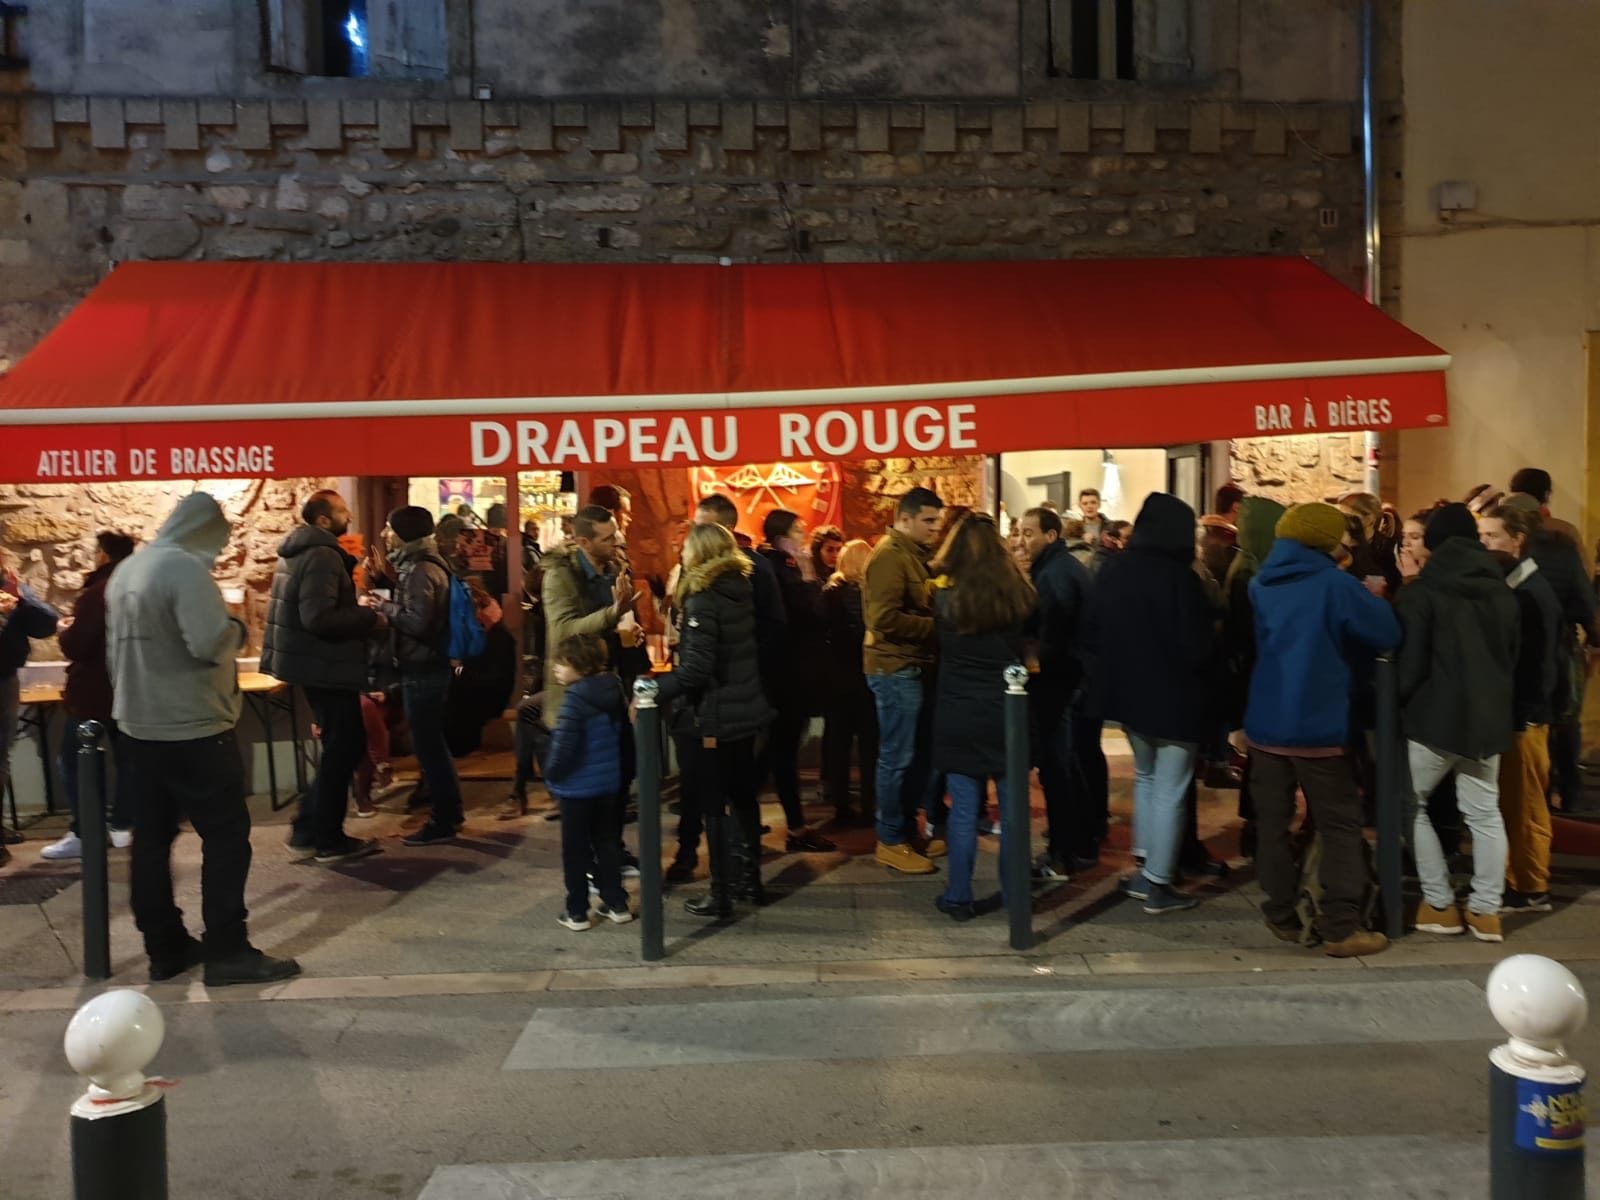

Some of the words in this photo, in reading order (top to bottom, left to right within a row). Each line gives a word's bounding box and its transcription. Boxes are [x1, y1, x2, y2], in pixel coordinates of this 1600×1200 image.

[1254, 404, 1293, 431] BAR
[1303, 396, 1317, 428] À
[1328, 395, 1393, 427] BIÈRES
[469, 416, 739, 467] DRAPEAU
[779, 404, 977, 457] ROUGE
[37, 449, 117, 477] ATELIER
[129, 448, 158, 475] DE
[171, 445, 275, 474] BRASSAGE
